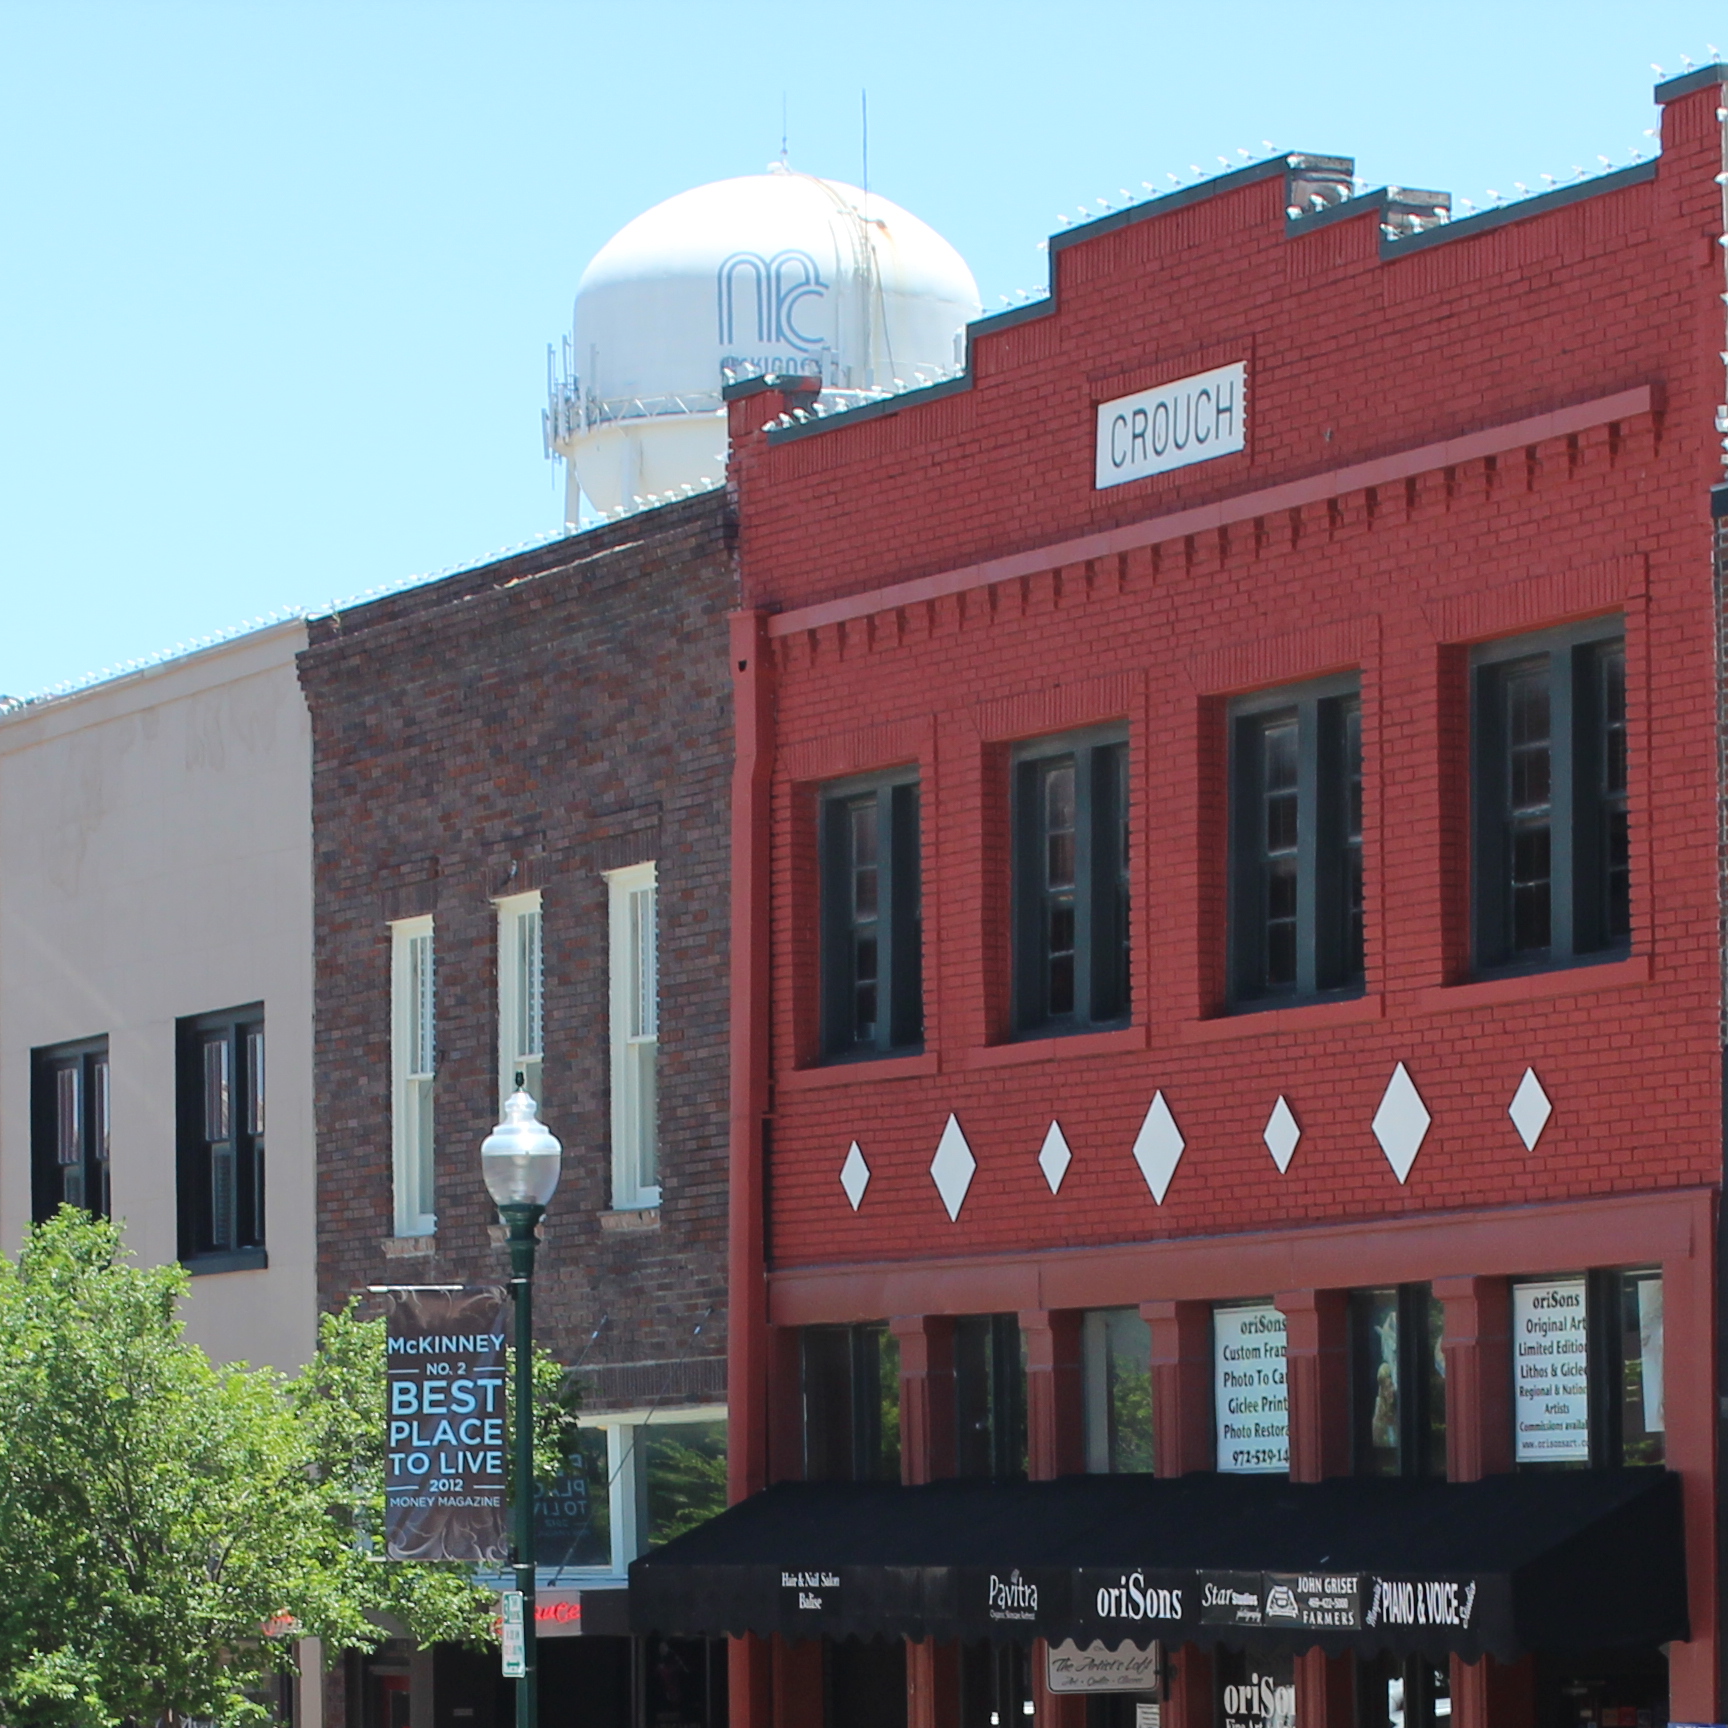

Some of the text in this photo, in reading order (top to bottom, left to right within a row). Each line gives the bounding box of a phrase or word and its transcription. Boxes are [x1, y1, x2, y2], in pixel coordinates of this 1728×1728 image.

[1111, 380, 1233, 468] CROUCH
[1532, 1290, 1580, 1310] oriSons
[1240, 1315, 1287, 1335] oriSons
[1526, 1315, 1587, 1337] Original Art
[388, 1334, 505, 1354] McKINNEY
[1519, 1341, 1554, 1356] Limited
[1223, 1345, 1261, 1361] Custom
[426, 1362, 466, 1375] NO. 2
[1520, 1364, 1548, 1379] Lithos
[1551, 1365, 1558, 1378] &
[1223, 1371, 1254, 1388] Photo
[1256, 1369, 1269, 1385] To
[391, 1378, 503, 1415] BEST
[1519, 1384, 1552, 1400] Regional
[1228, 1398, 1259, 1414] Giclee
[1544, 1403, 1570, 1415] Artists
[390, 1418, 503, 1447] PLACE
[1224, 1424, 1252, 1439] Photo
[388, 1451, 502, 1475] TO LIVE
[429, 1479, 463, 1492] 2012
[390, 1496, 501, 1507] MONEY MAGAZINE
[821, 1572, 840, 1587] Salon
[1297, 1577, 1358, 1593] JOHN GRISET
[989, 1574, 1037, 1611] Pavitra
[1096, 1572, 1183, 1620] oriSons
[1202, 1583, 1232, 1606] Star
[1382, 1581, 1414, 1624] PIANO
[1417, 1582, 1426, 1625] &
[1425, 1581, 1459, 1625] VOICE
[1303, 1610, 1355, 1625] FARMERS
